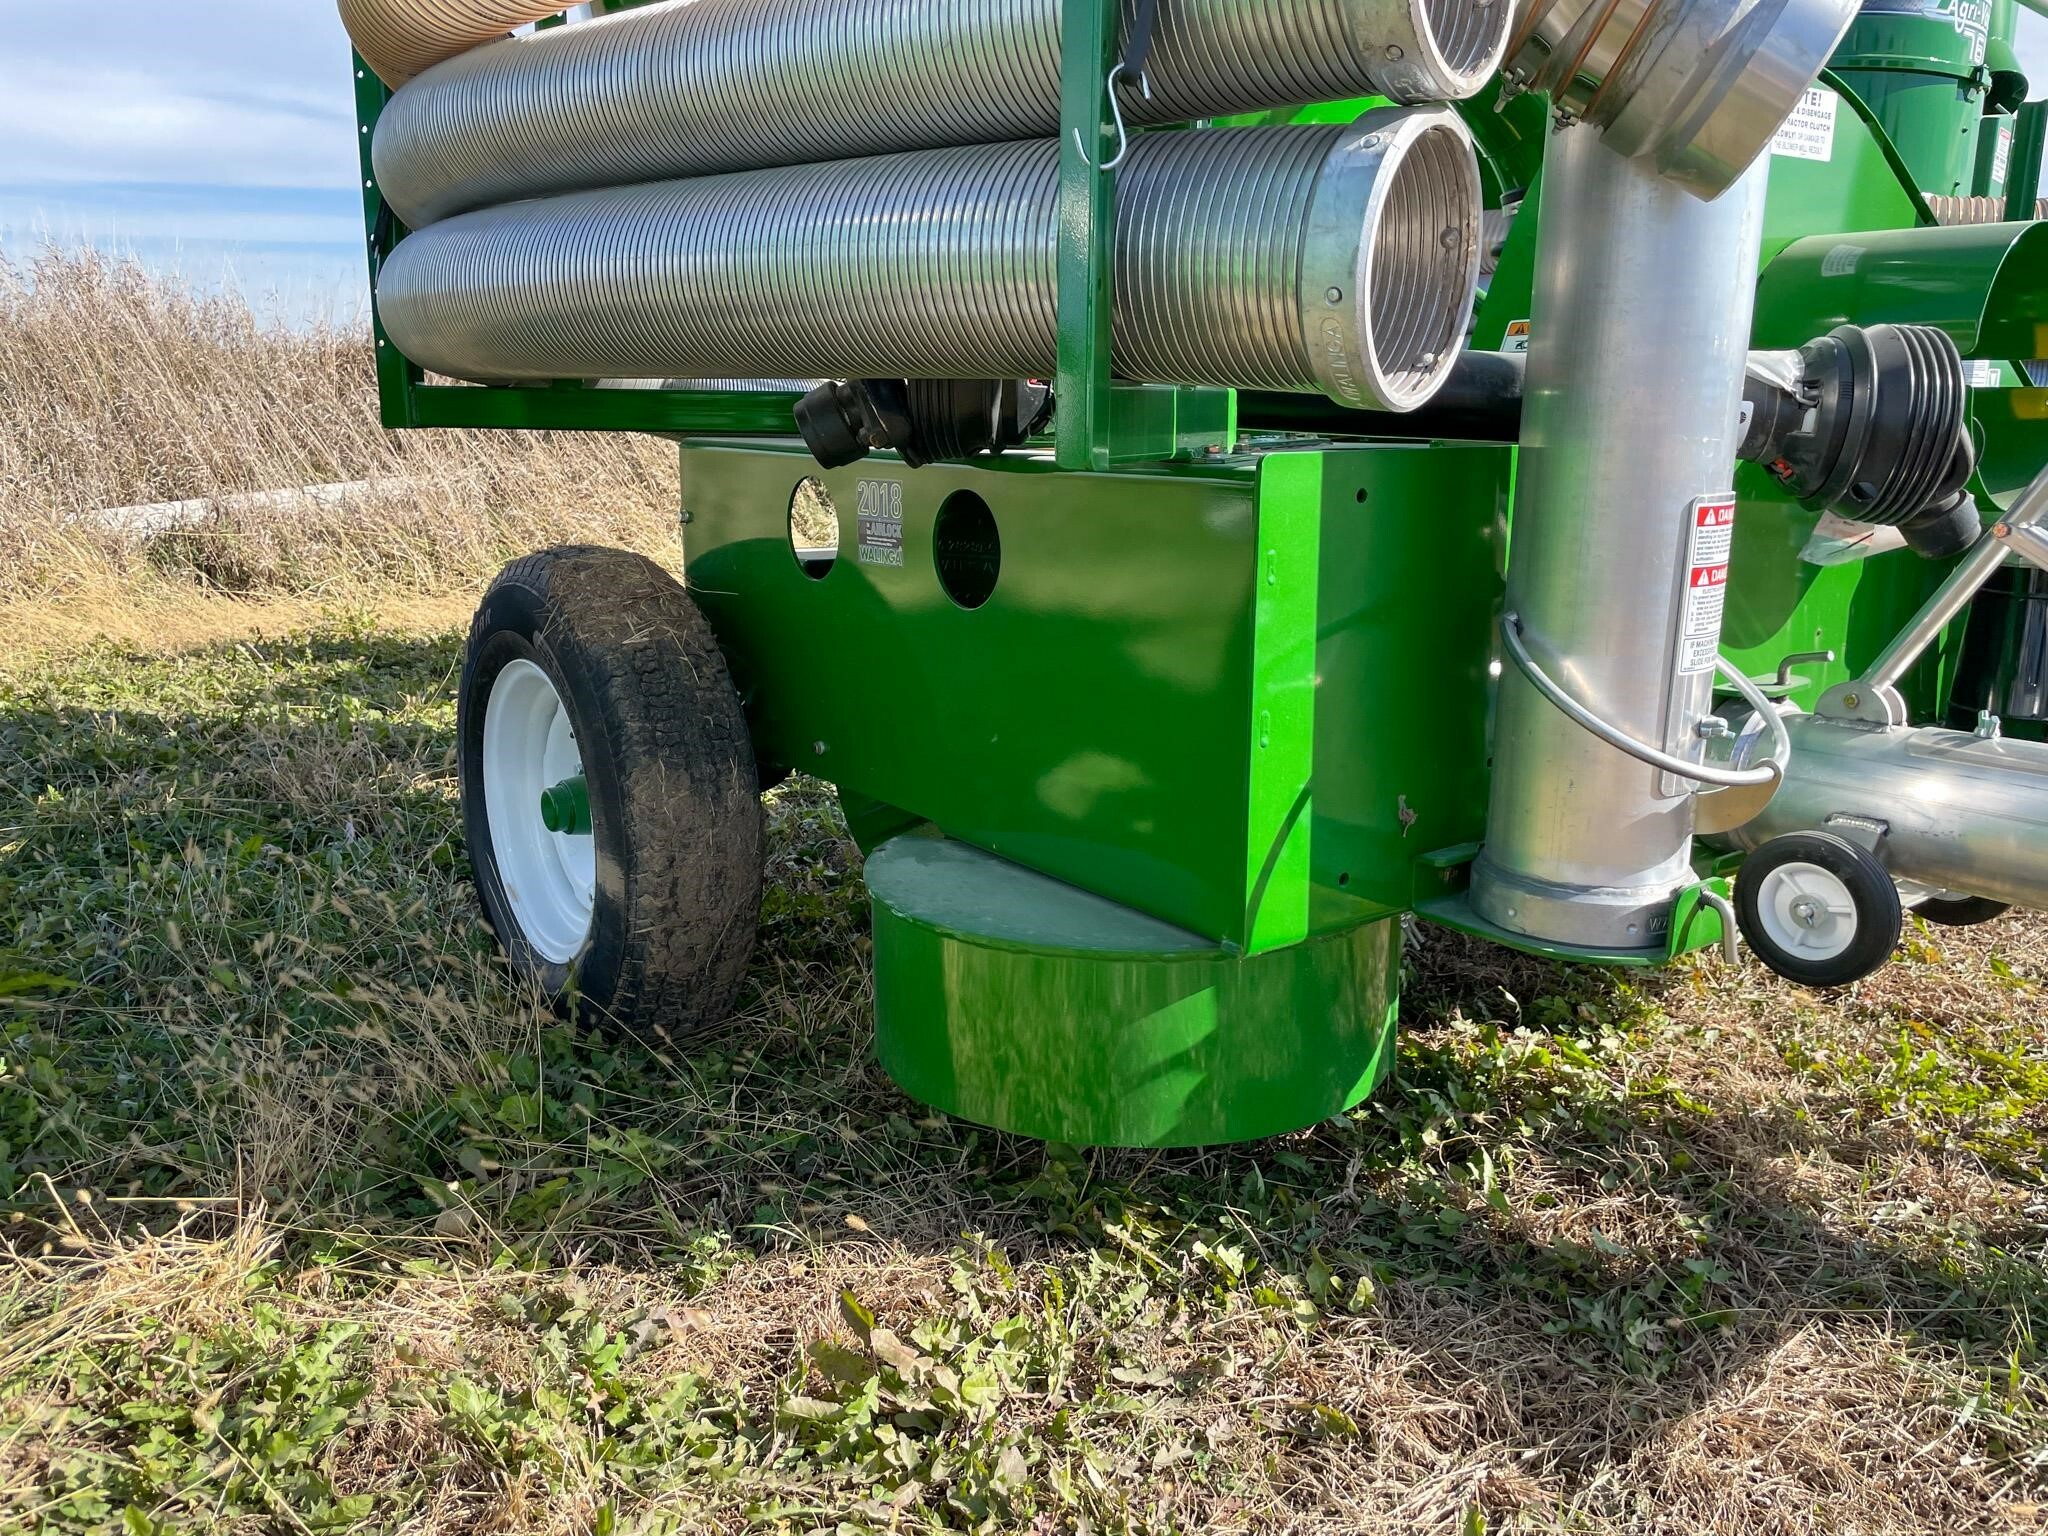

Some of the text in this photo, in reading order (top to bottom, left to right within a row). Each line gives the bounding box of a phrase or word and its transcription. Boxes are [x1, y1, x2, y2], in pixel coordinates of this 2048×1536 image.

[1801, 107, 1832, 120] DISENGAGE
[1785, 118, 1830, 132] RACTOR CLUTCH
[857, 480, 903, 519] 2018
[859, 543, 903, 567] WALINGA
